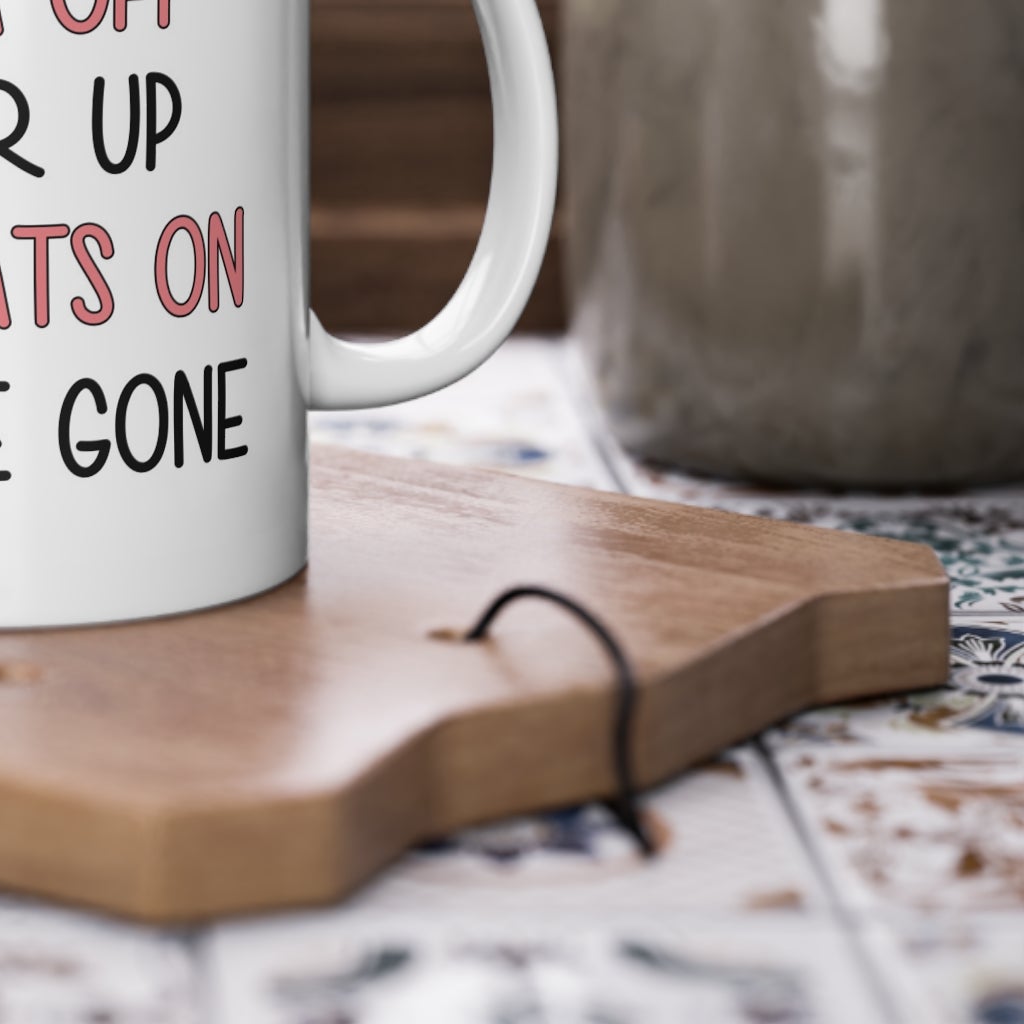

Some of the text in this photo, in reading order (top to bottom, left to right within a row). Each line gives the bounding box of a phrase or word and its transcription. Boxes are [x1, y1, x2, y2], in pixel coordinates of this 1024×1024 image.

[91, 71, 183, 175] UP
[153, 205, 245, 319] ON
[57, 356, 249, 479] GONE
